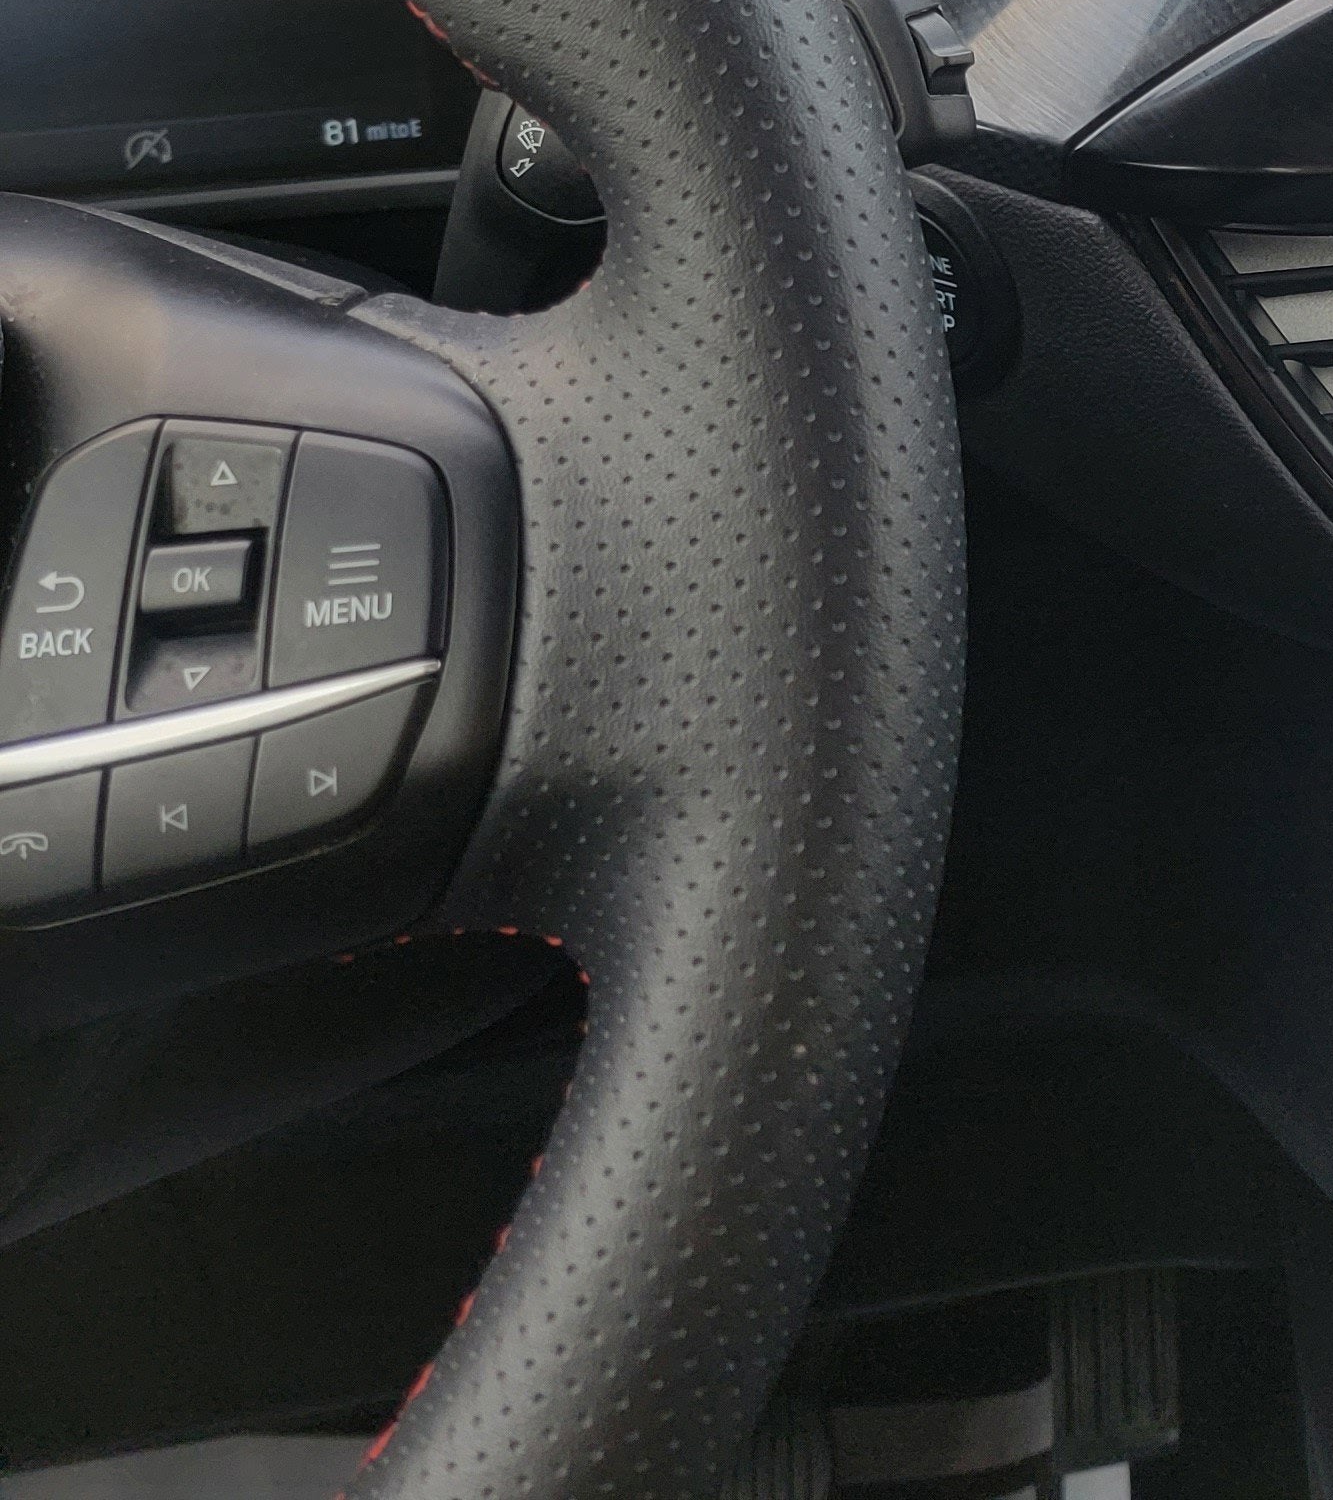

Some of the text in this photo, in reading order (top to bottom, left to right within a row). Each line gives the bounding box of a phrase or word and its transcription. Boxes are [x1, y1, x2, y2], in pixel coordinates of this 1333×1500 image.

[322, 118, 360, 147] 81
[409, 118, 422, 140] E
[172, 568, 211, 592] OK
[304, 592, 394, 628] MENU
[19, 627, 94, 660] BACK
